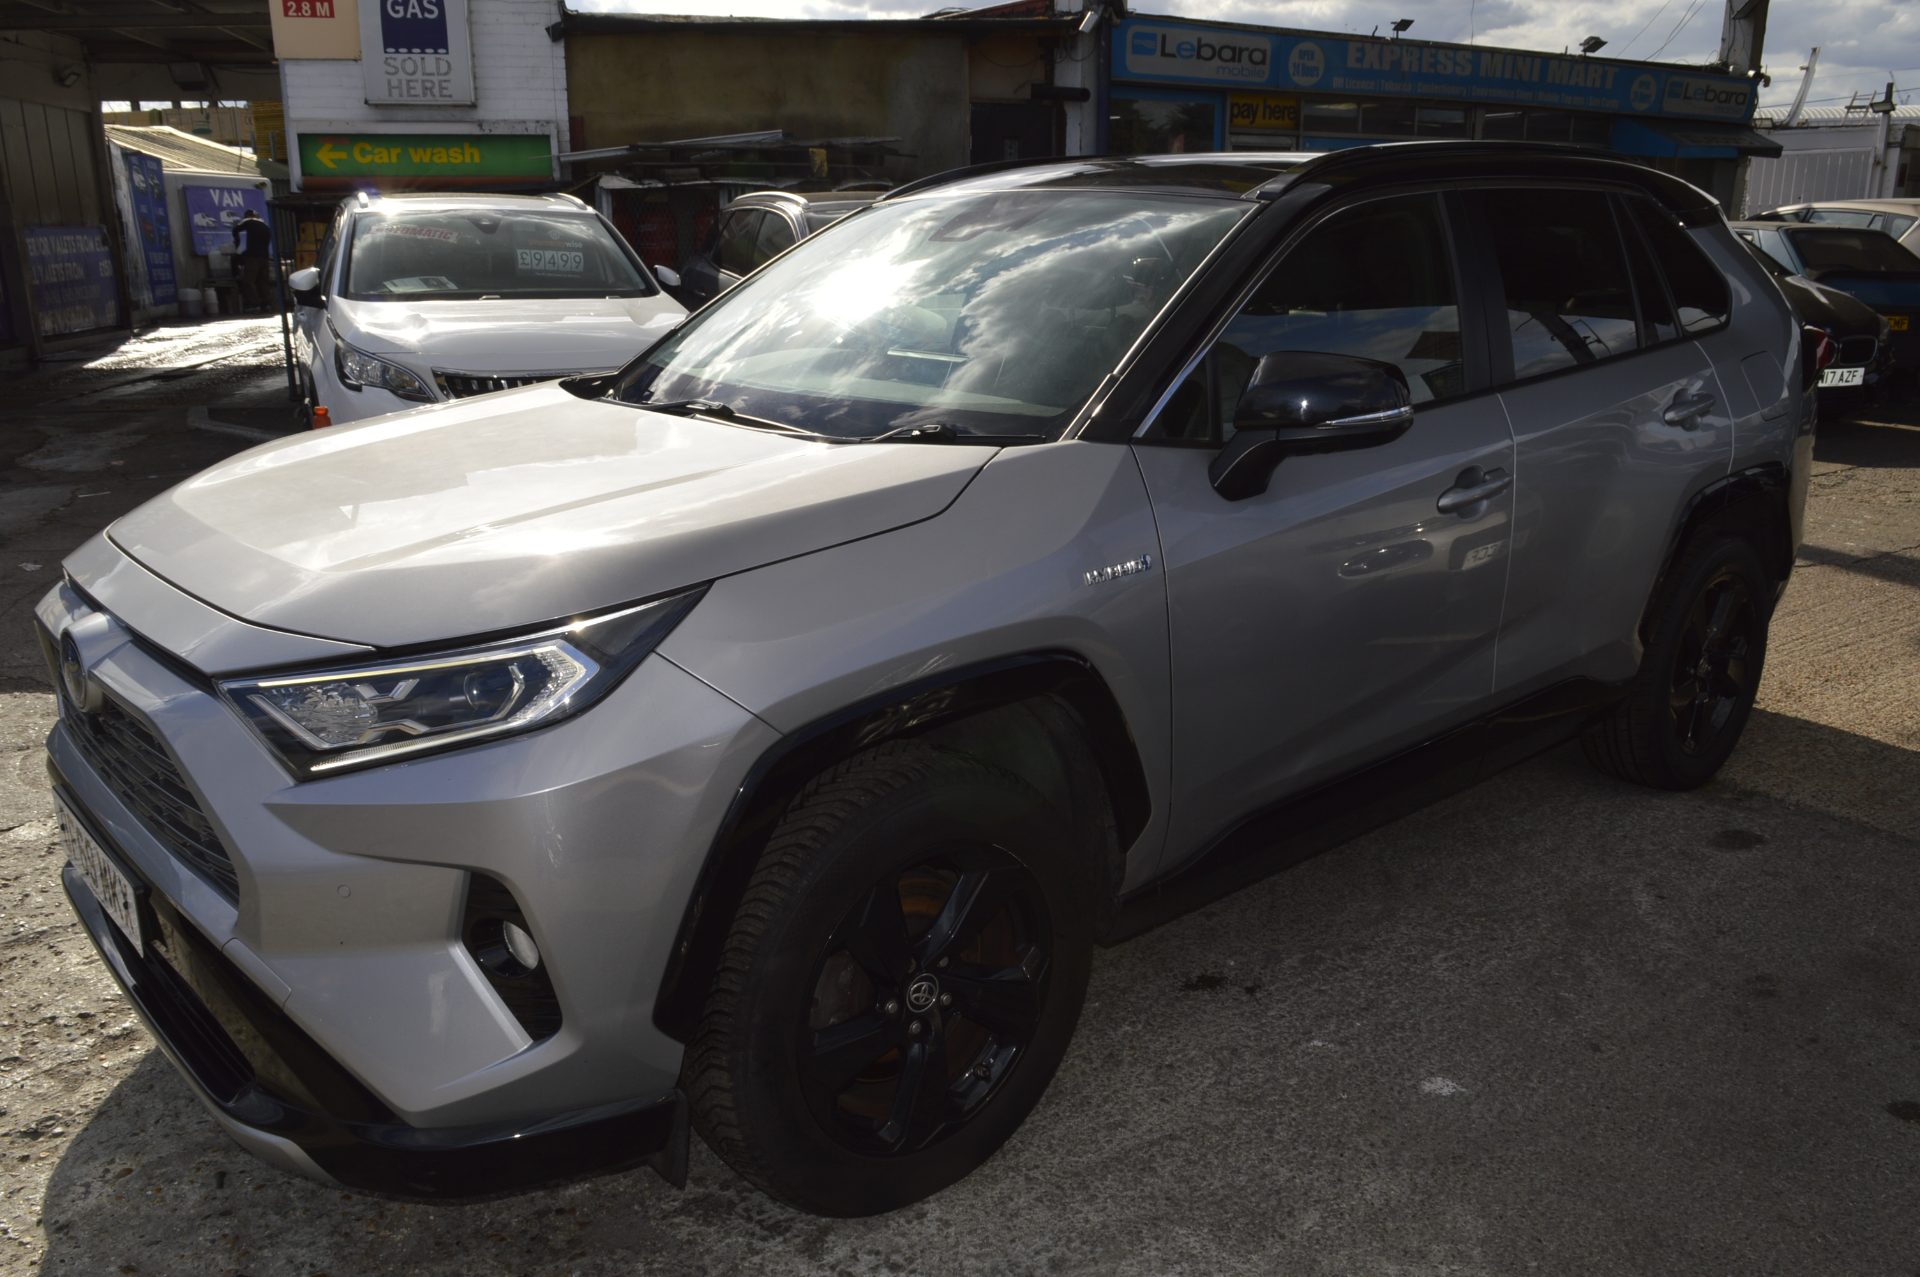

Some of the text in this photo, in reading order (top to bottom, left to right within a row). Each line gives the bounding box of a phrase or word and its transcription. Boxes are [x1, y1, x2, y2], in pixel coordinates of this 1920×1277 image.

[288, 3, 330, 17] 2.8 M
[386, 0, 439, 18] GAS
[1160, 32, 1267, 65] Lebara
[384, 56, 453, 77] SOLD
[1216, 65, 1266, 79] mobile
[1346, 41, 1620, 88] EXPRESS MINI MART
[386, 78, 453, 98] HERE
[1683, 81, 1748, 105] Lebara
[1231, 97, 1297, 125] pay here
[352, 142, 481, 165] Car wash
[209, 188, 245, 208] VAN
[371, 224, 451, 241] TOMATIC
[519, 251, 583, 269] £9499
[1838, 370, 1858, 384] AZF
